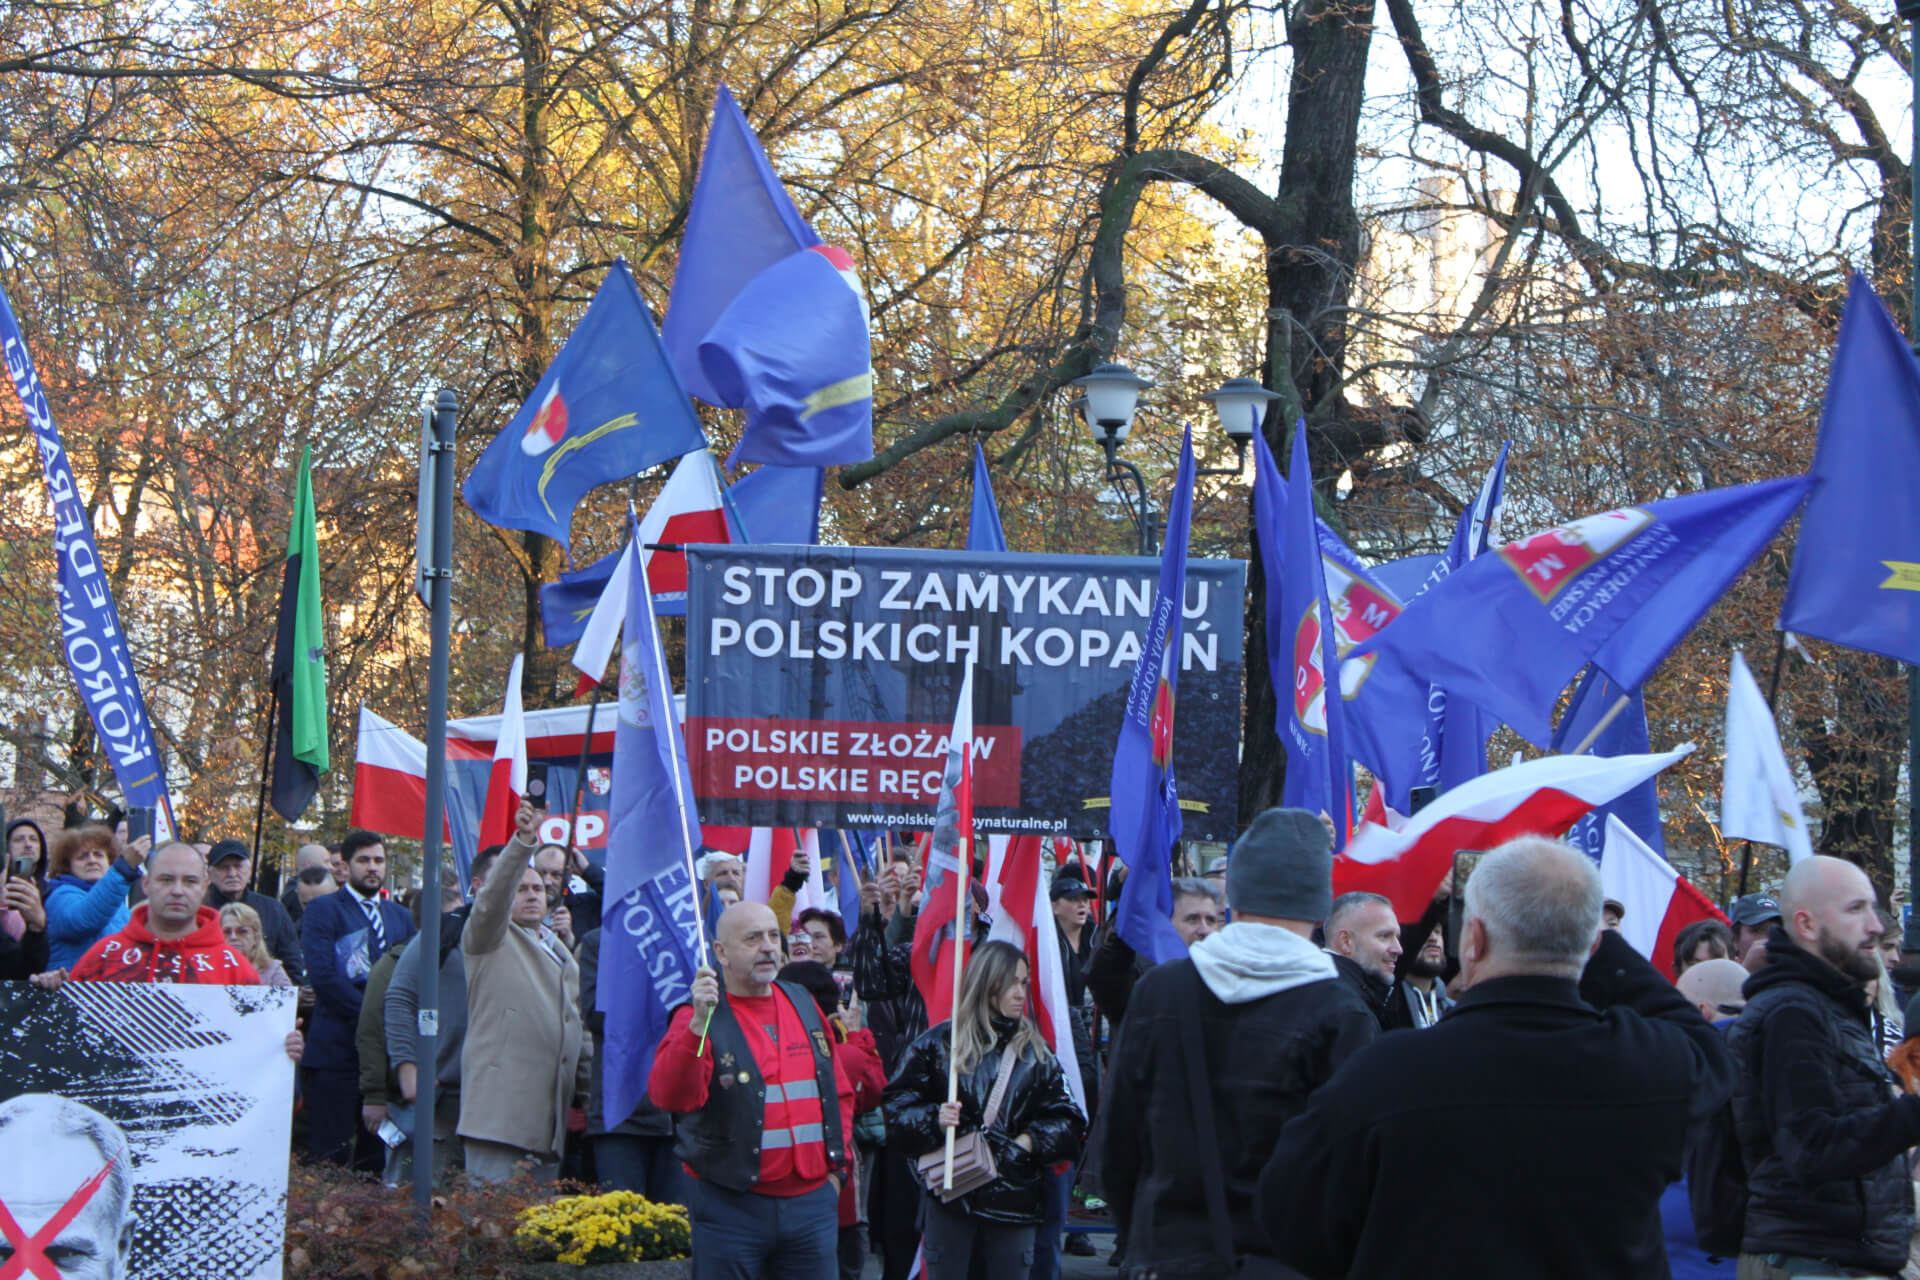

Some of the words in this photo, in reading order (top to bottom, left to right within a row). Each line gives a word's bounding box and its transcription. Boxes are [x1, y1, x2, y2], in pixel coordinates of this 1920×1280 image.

[722, 566, 862, 608] STOP
[880, 570, 1209, 619] ZAMYKANU
[711, 617, 979, 664] POLSKICH
[1001, 620, 1218, 671] KOPAŃ
[706, 728, 839, 755] POLSKIE
[735, 765, 868, 793] POLSKIE
[879, 769, 943, 800] RĘC
